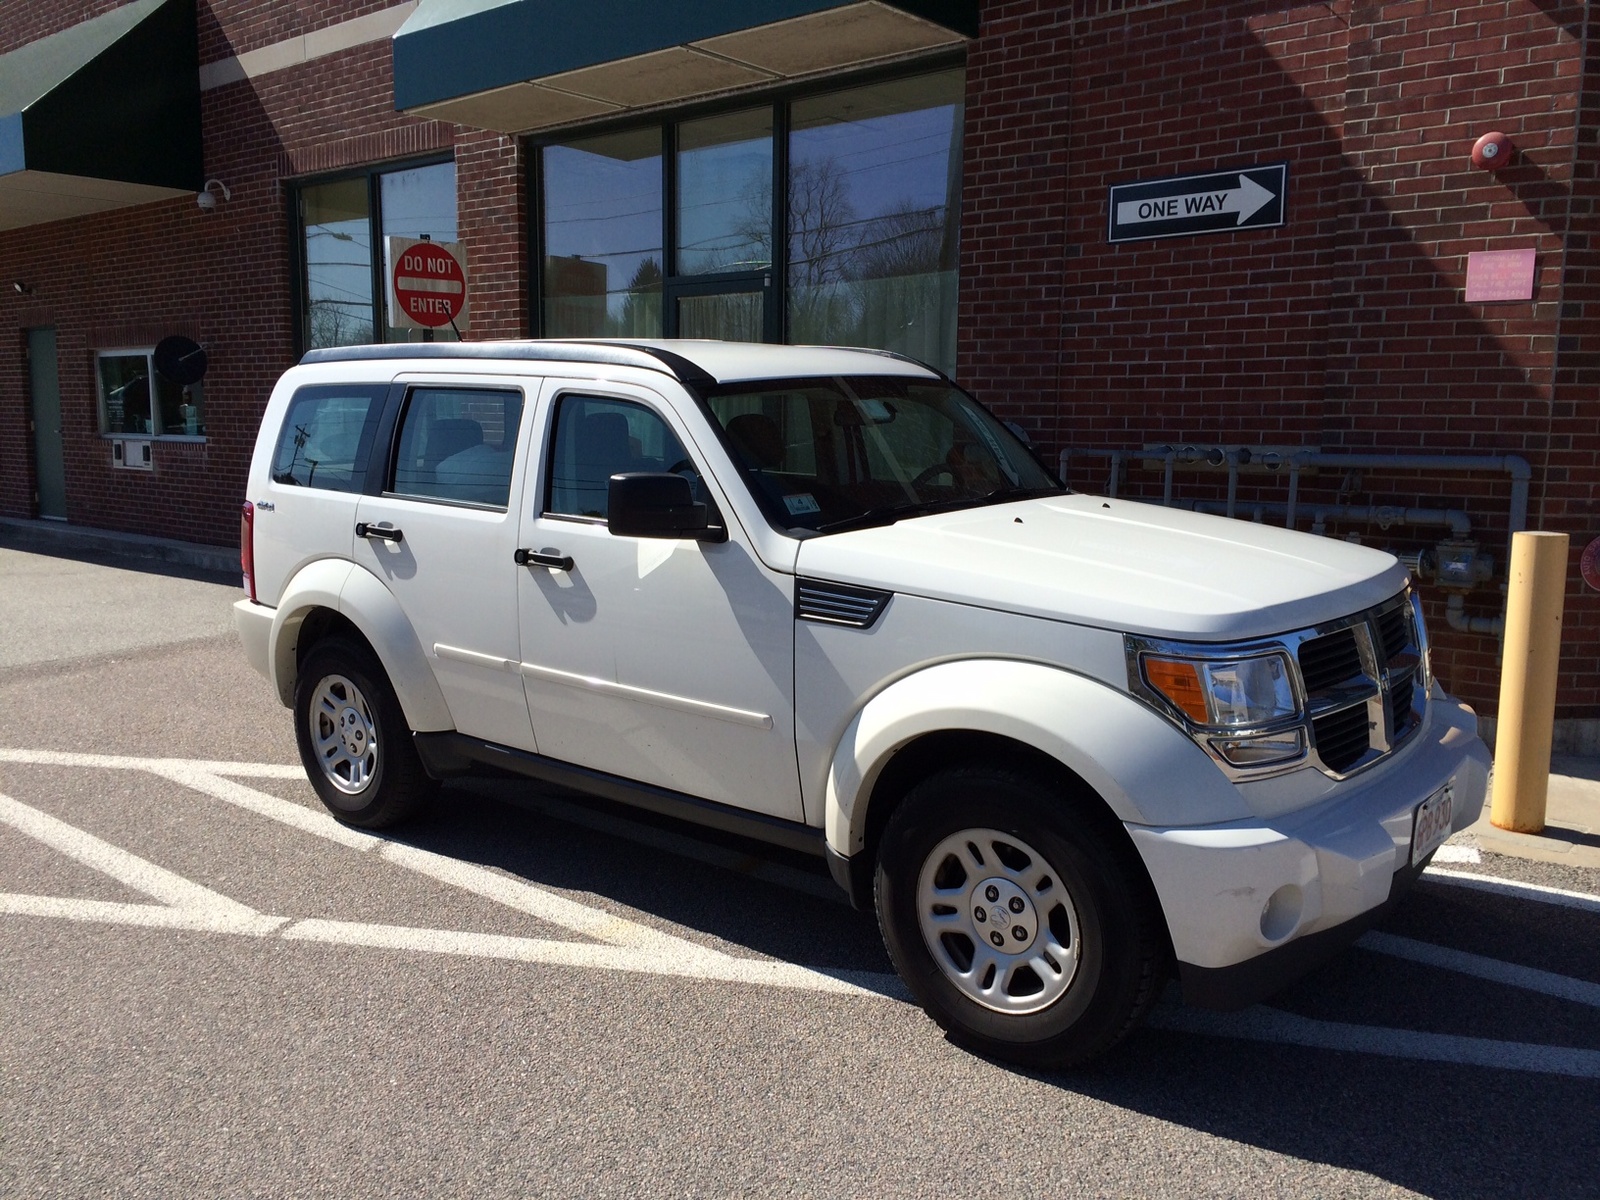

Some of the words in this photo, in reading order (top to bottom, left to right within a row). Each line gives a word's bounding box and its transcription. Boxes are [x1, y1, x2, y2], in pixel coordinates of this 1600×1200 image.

[1138, 200, 1178, 219] ONE
[1185, 193, 1228, 214] WAY
[404, 255, 422, 272] DO
[427, 257, 453, 274] NOT
[410, 297, 452, 314] ENTER
